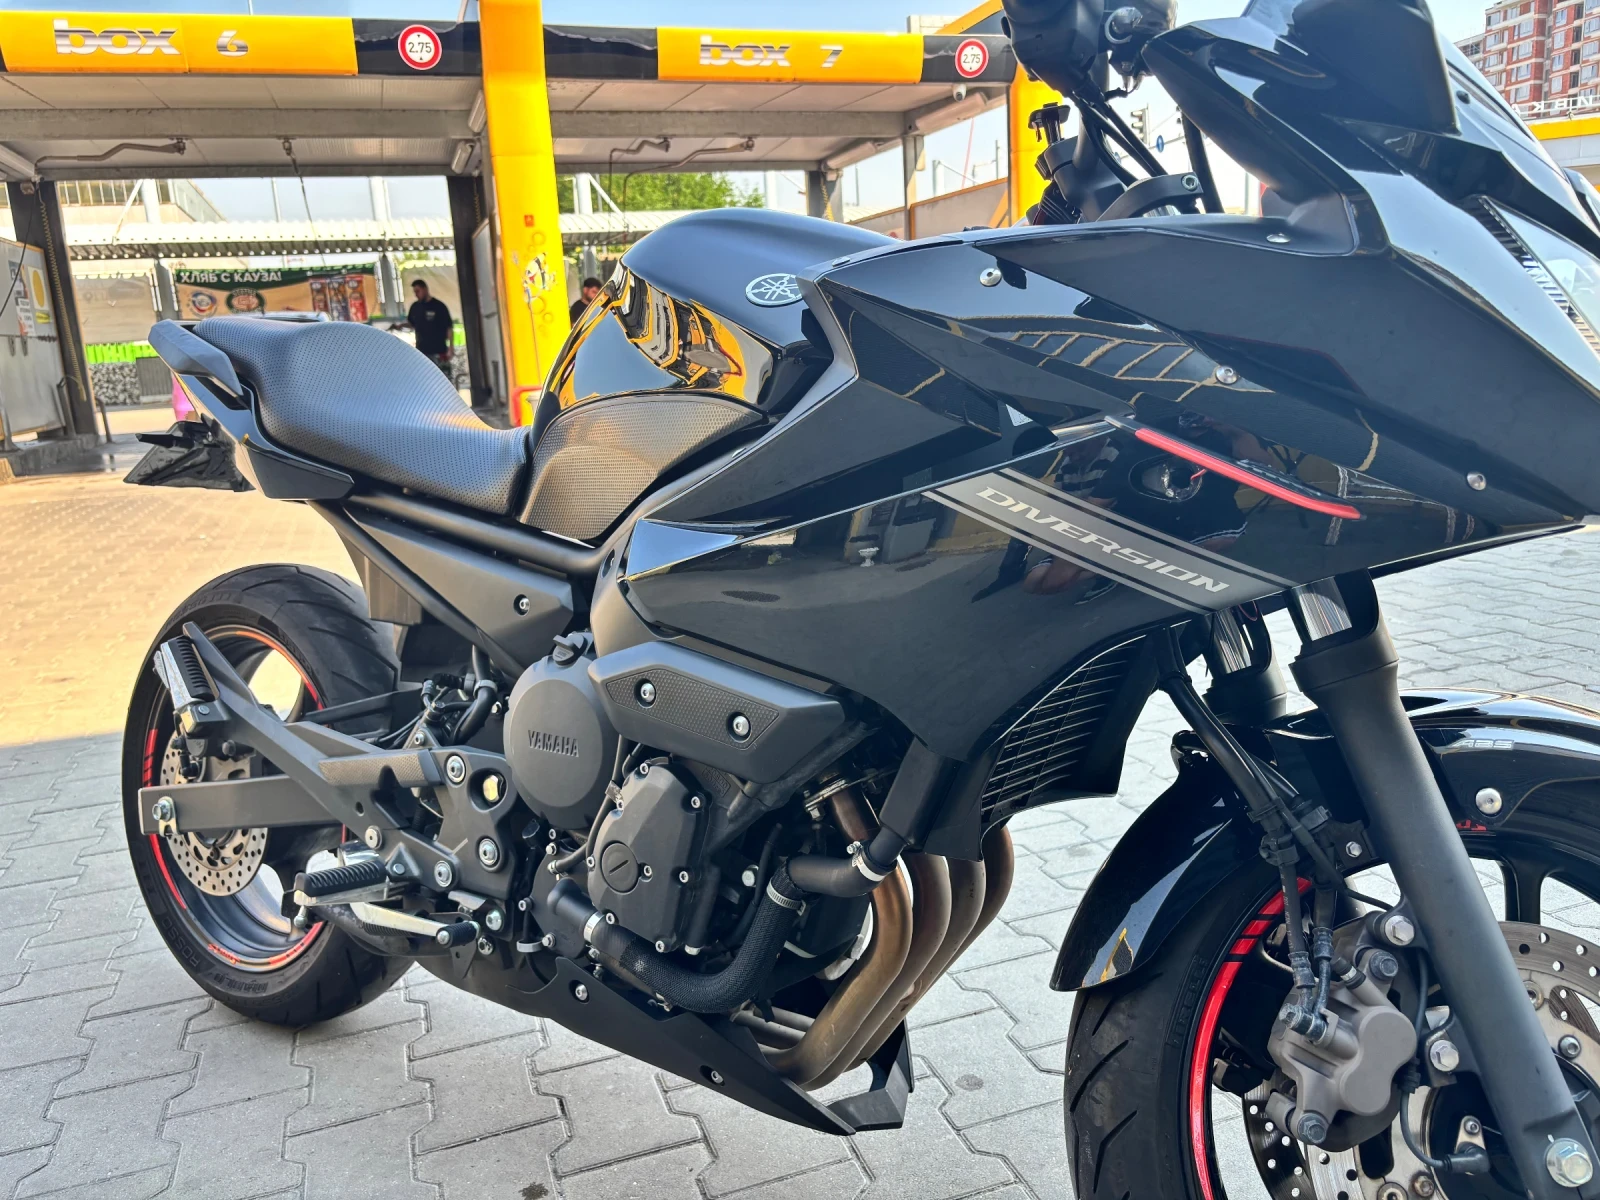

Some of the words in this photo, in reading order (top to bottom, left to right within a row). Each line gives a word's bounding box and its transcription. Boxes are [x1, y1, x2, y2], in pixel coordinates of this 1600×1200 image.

[53, 18, 181, 55] box
[216, 30, 249, 57] 6
[408, 41, 432, 53] 2.75
[700, 35, 791, 67] box
[820, 45, 844, 68] 7
[963, 53, 981, 64] 2.75
[180, 272, 218, 284] ХЛЯБ
[233, 271, 283, 283] КАУЗА!
[975, 486, 1230, 593] DIVERSION
[527, 729, 580, 758] YAMAHA
[1450, 738, 1514, 751] ABS
